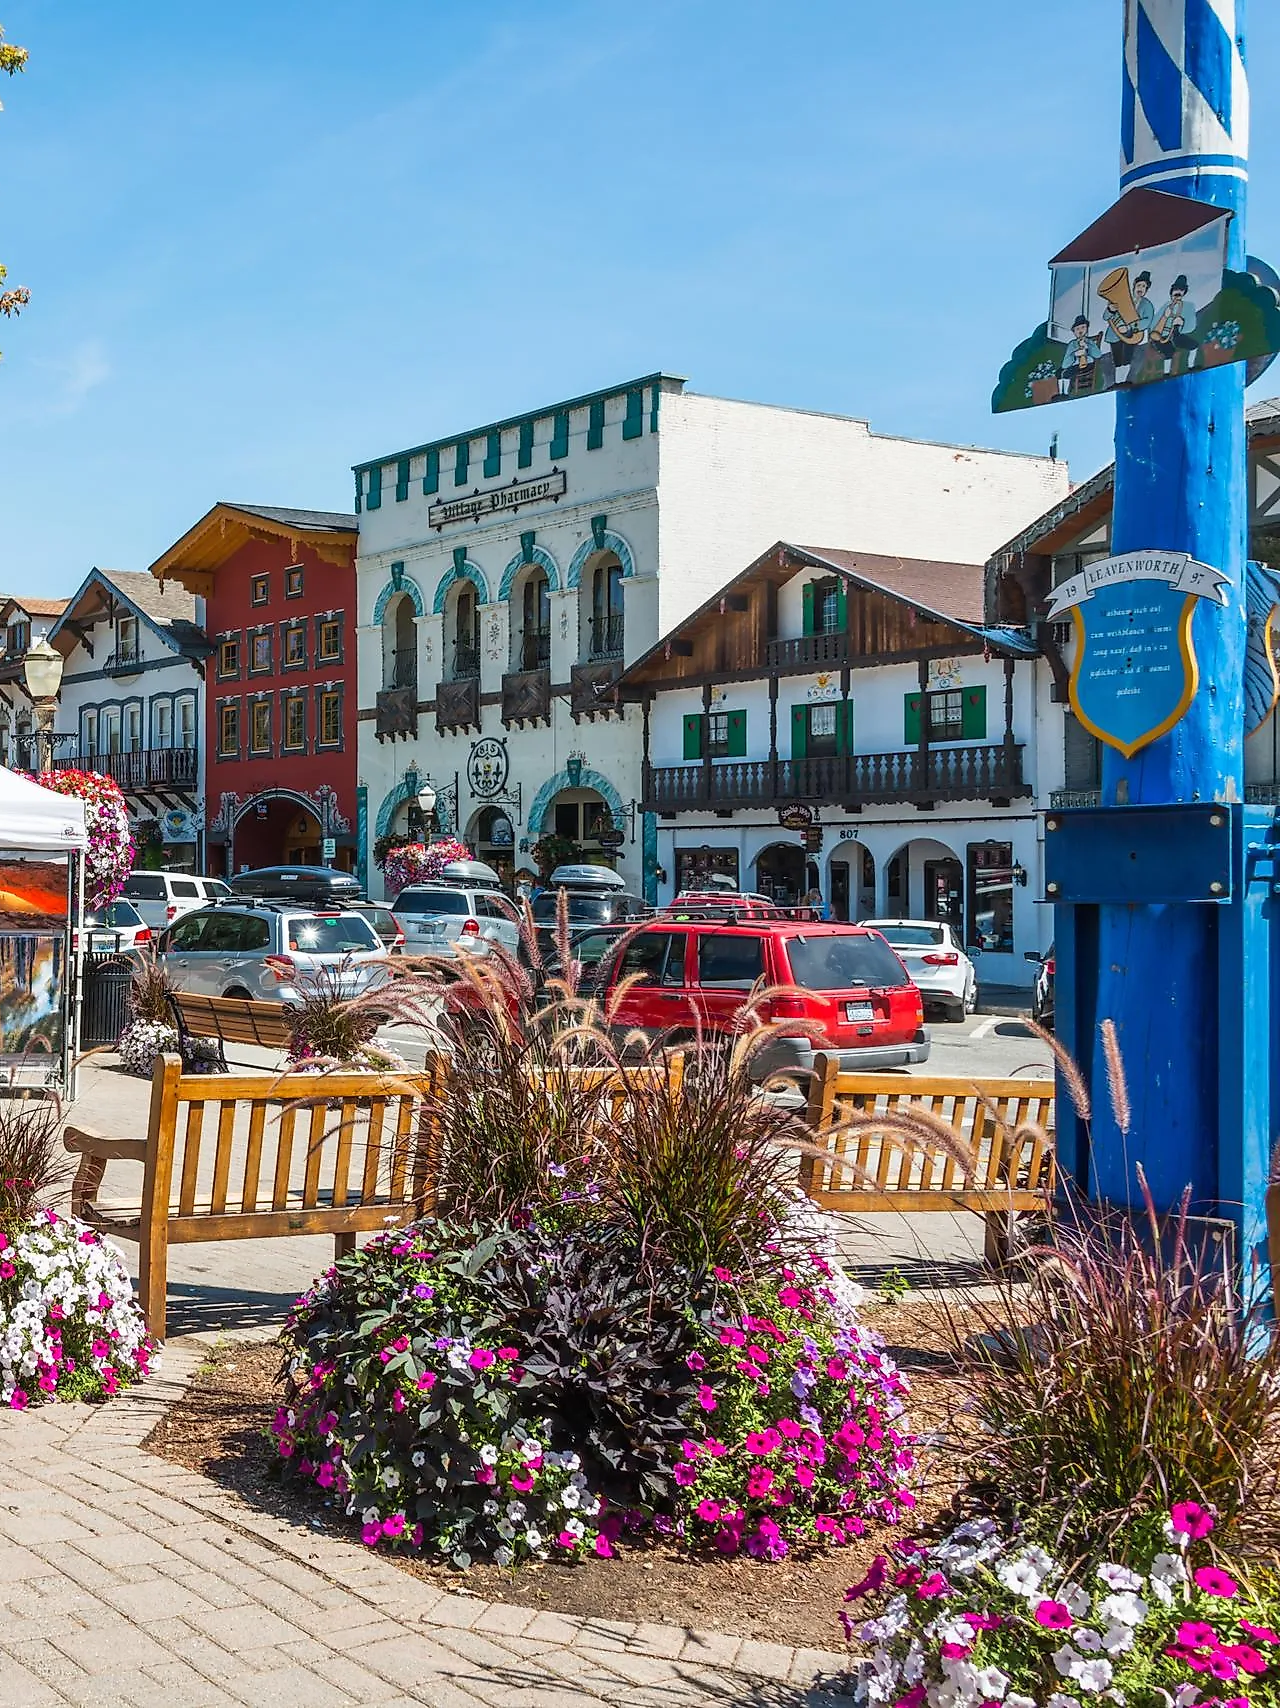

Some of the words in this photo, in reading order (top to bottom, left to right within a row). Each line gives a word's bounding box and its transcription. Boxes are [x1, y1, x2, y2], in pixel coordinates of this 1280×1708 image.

[440, 501, 482, 519] Village
[490, 482, 550, 510] Pharmacy
[1065, 585, 1077, 598] 19
[1088, 559, 1180, 583] LEAVENWORTH
[1190, 572, 1205, 585] 97
[480, 744, 496, 754] 815
[840, 830, 859, 839] 807
